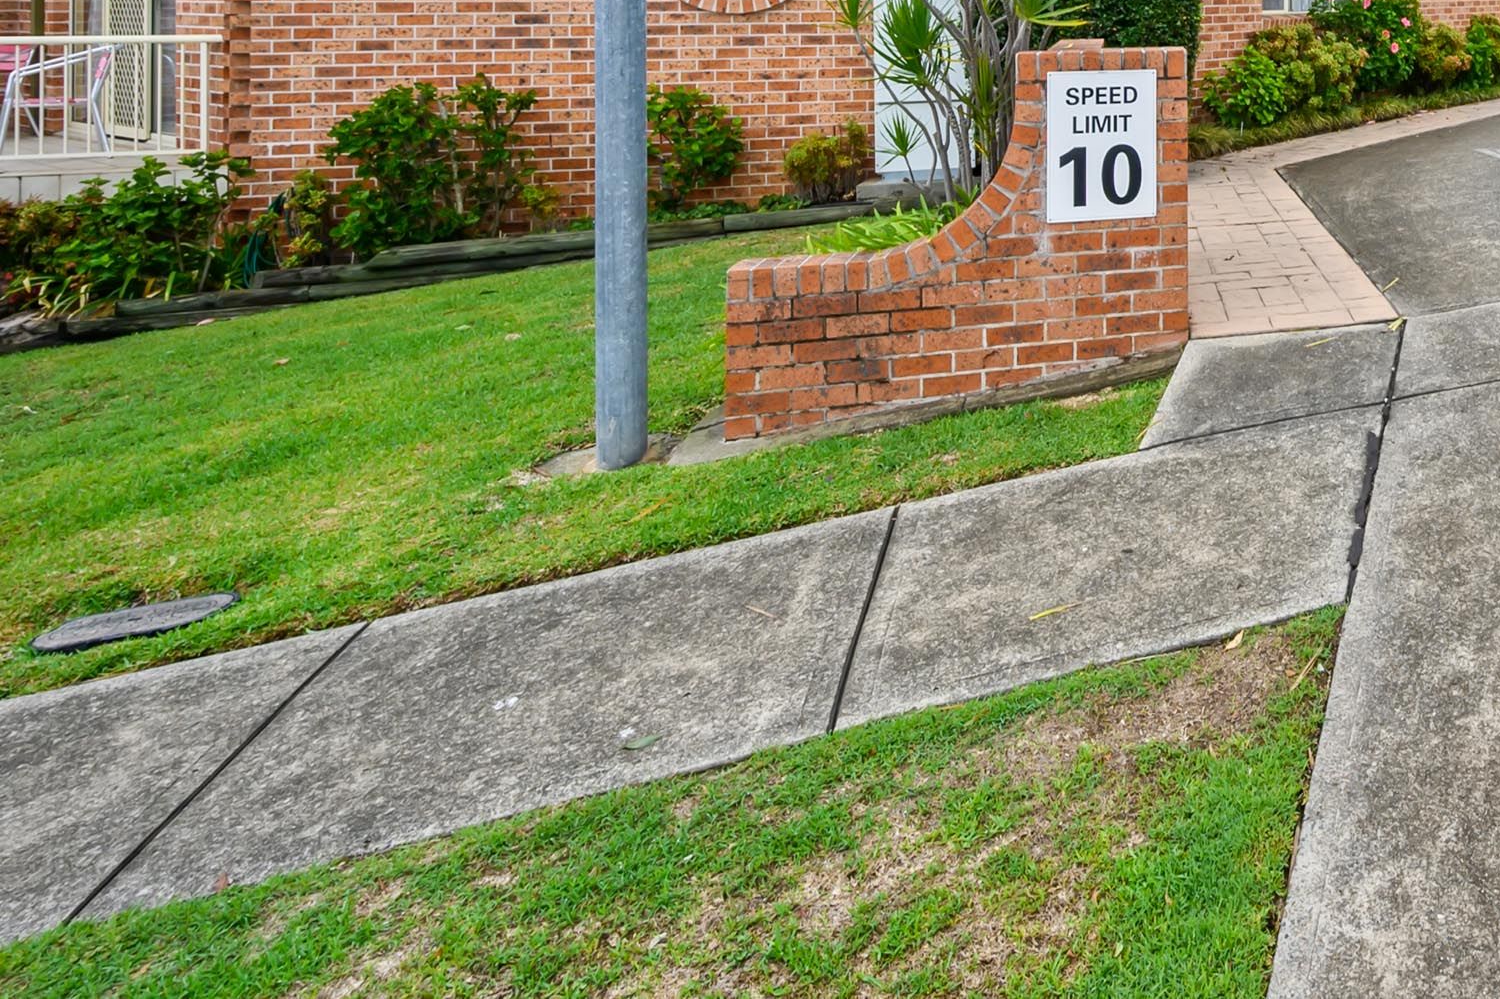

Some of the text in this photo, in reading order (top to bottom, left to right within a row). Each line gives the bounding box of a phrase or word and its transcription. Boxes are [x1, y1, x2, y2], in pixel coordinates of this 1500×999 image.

[1065, 86, 1138, 106] SPEED
[1072, 114, 1132, 134] LIMIT
[1059, 143, 1143, 208] 10
